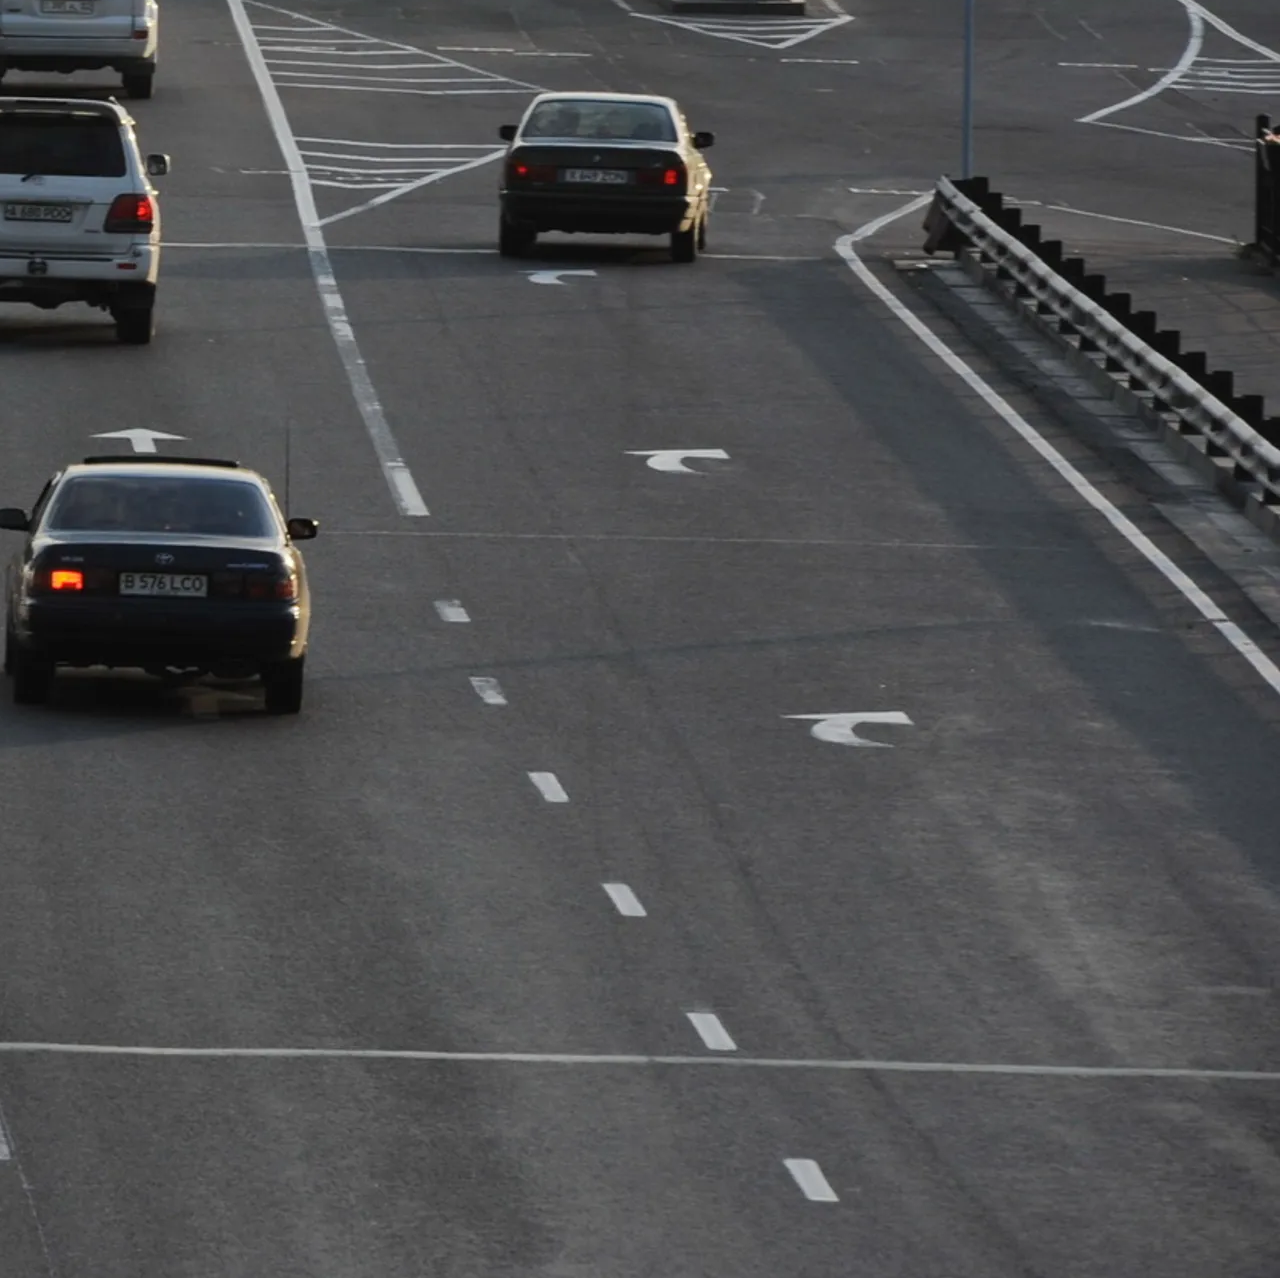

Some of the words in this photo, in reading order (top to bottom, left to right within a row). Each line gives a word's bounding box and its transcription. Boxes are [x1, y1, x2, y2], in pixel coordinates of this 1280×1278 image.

[124, 575, 135, 589] B
[140, 575, 166, 590] 576
[170, 576, 203, 592] LCO
